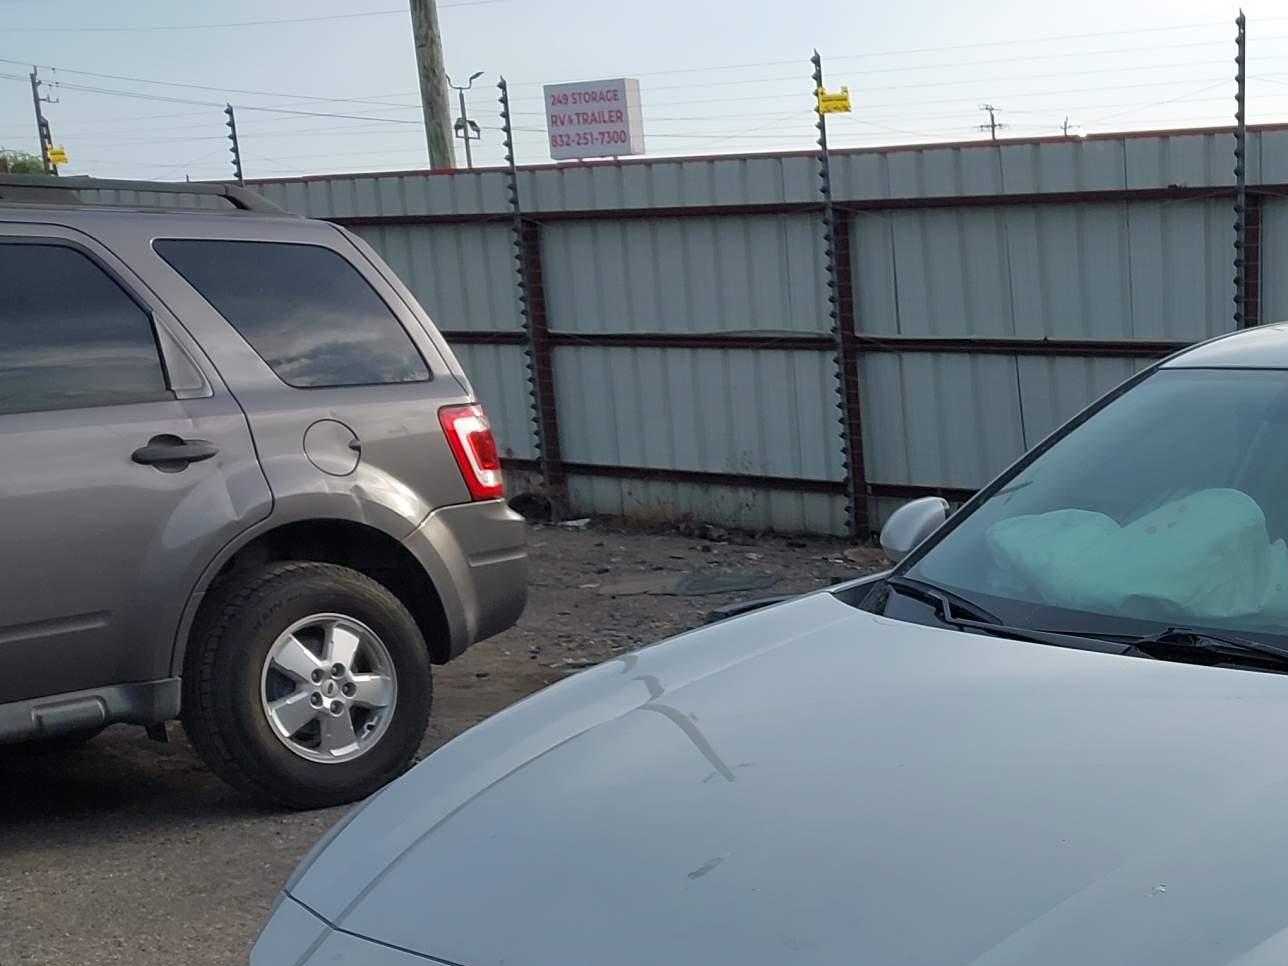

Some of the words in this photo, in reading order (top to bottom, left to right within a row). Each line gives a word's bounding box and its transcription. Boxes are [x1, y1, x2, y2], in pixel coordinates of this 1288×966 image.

[571, 89, 620, 105] STORAGE
[550, 113, 566, 128] RV
[574, 110, 624, 126] TRAILER
[551, 130, 627, 148] 832-251-7300
